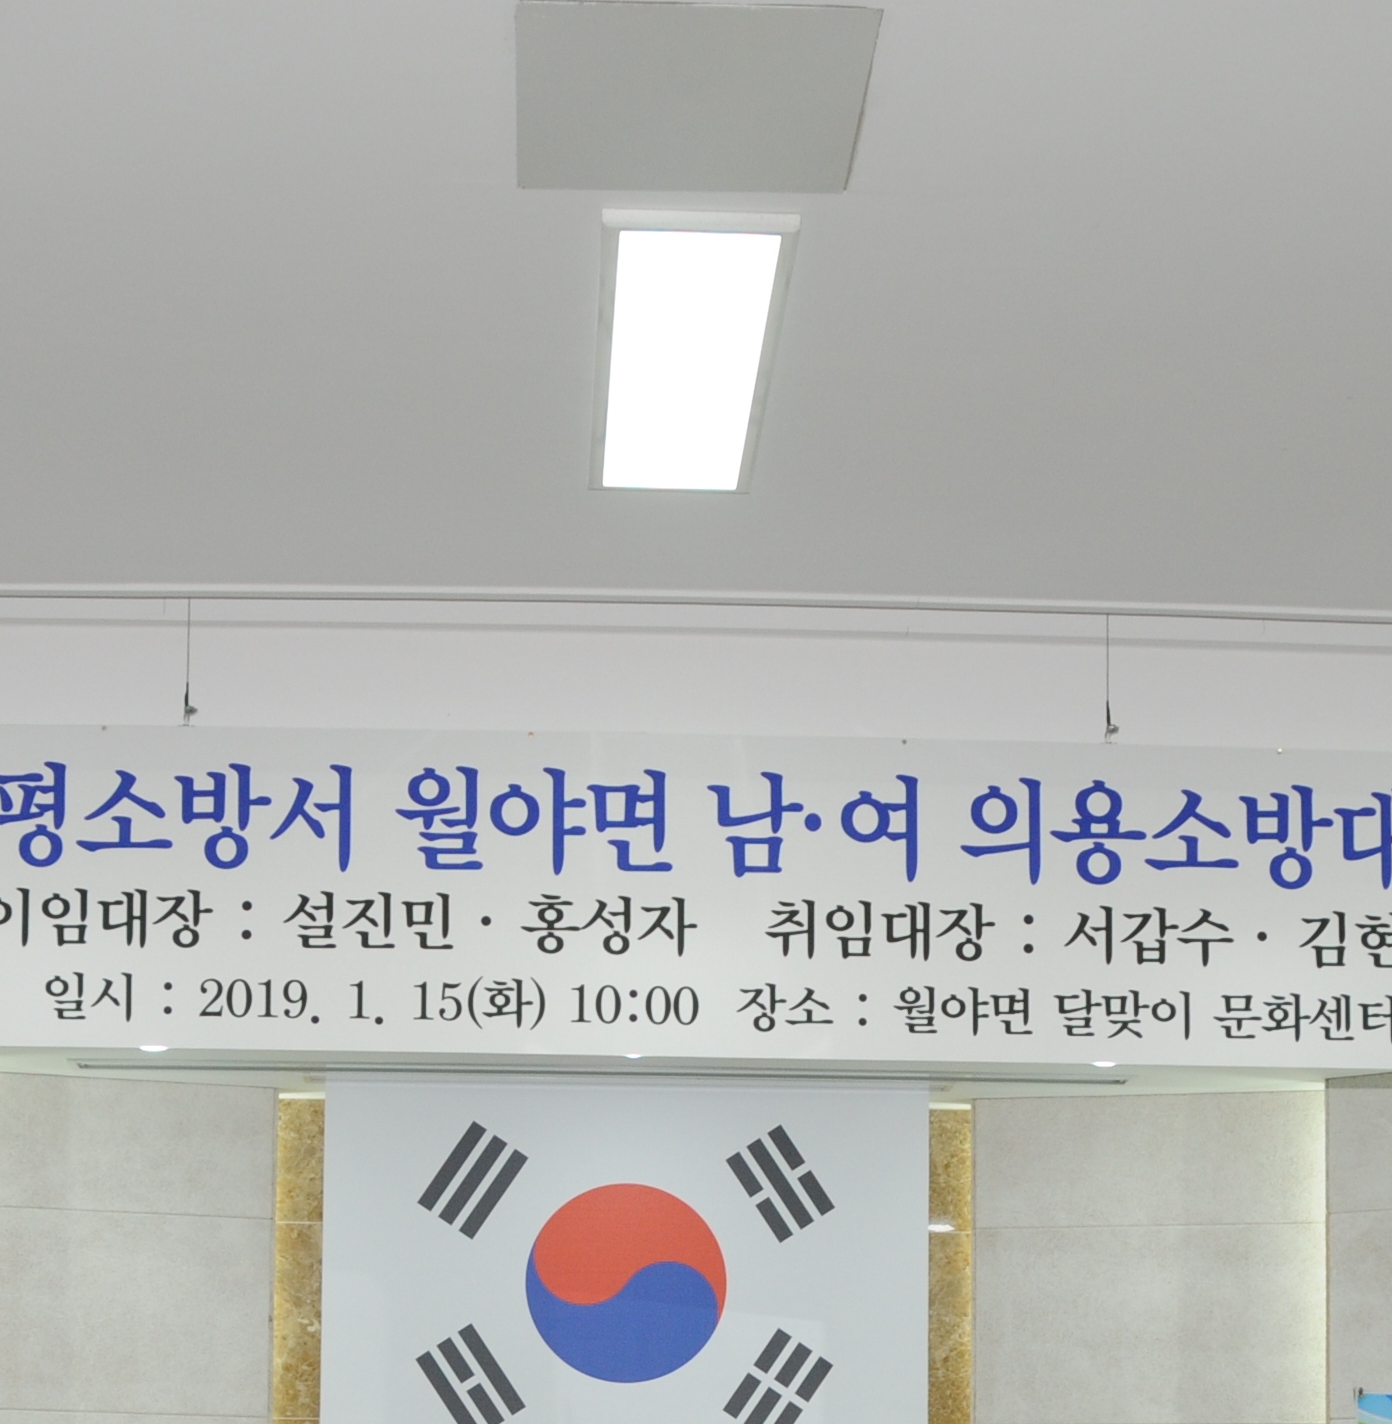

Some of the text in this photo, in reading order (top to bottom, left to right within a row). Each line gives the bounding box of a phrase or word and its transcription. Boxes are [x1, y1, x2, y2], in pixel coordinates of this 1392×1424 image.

[396, 766, 674, 876] 월야면
[283, 891, 454, 950] 설진민
[520, 894, 698, 957] 홍성자
[765, 898, 996, 962] 취임대장
[1064, 905, 1235, 968] 서갑수
[44, 971, 136, 1023] 일시
[199, 978, 320, 1025] 2019.
[349, 980, 385, 1026] 1.
[412, 977, 547, 1030] 15(화)
[571, 983, 700, 1026] 10:00
[736, 983, 835, 1032] 장소
[893, 985, 1034, 1037] 월야면
[1054, 988, 1192, 1040] 달맞이
